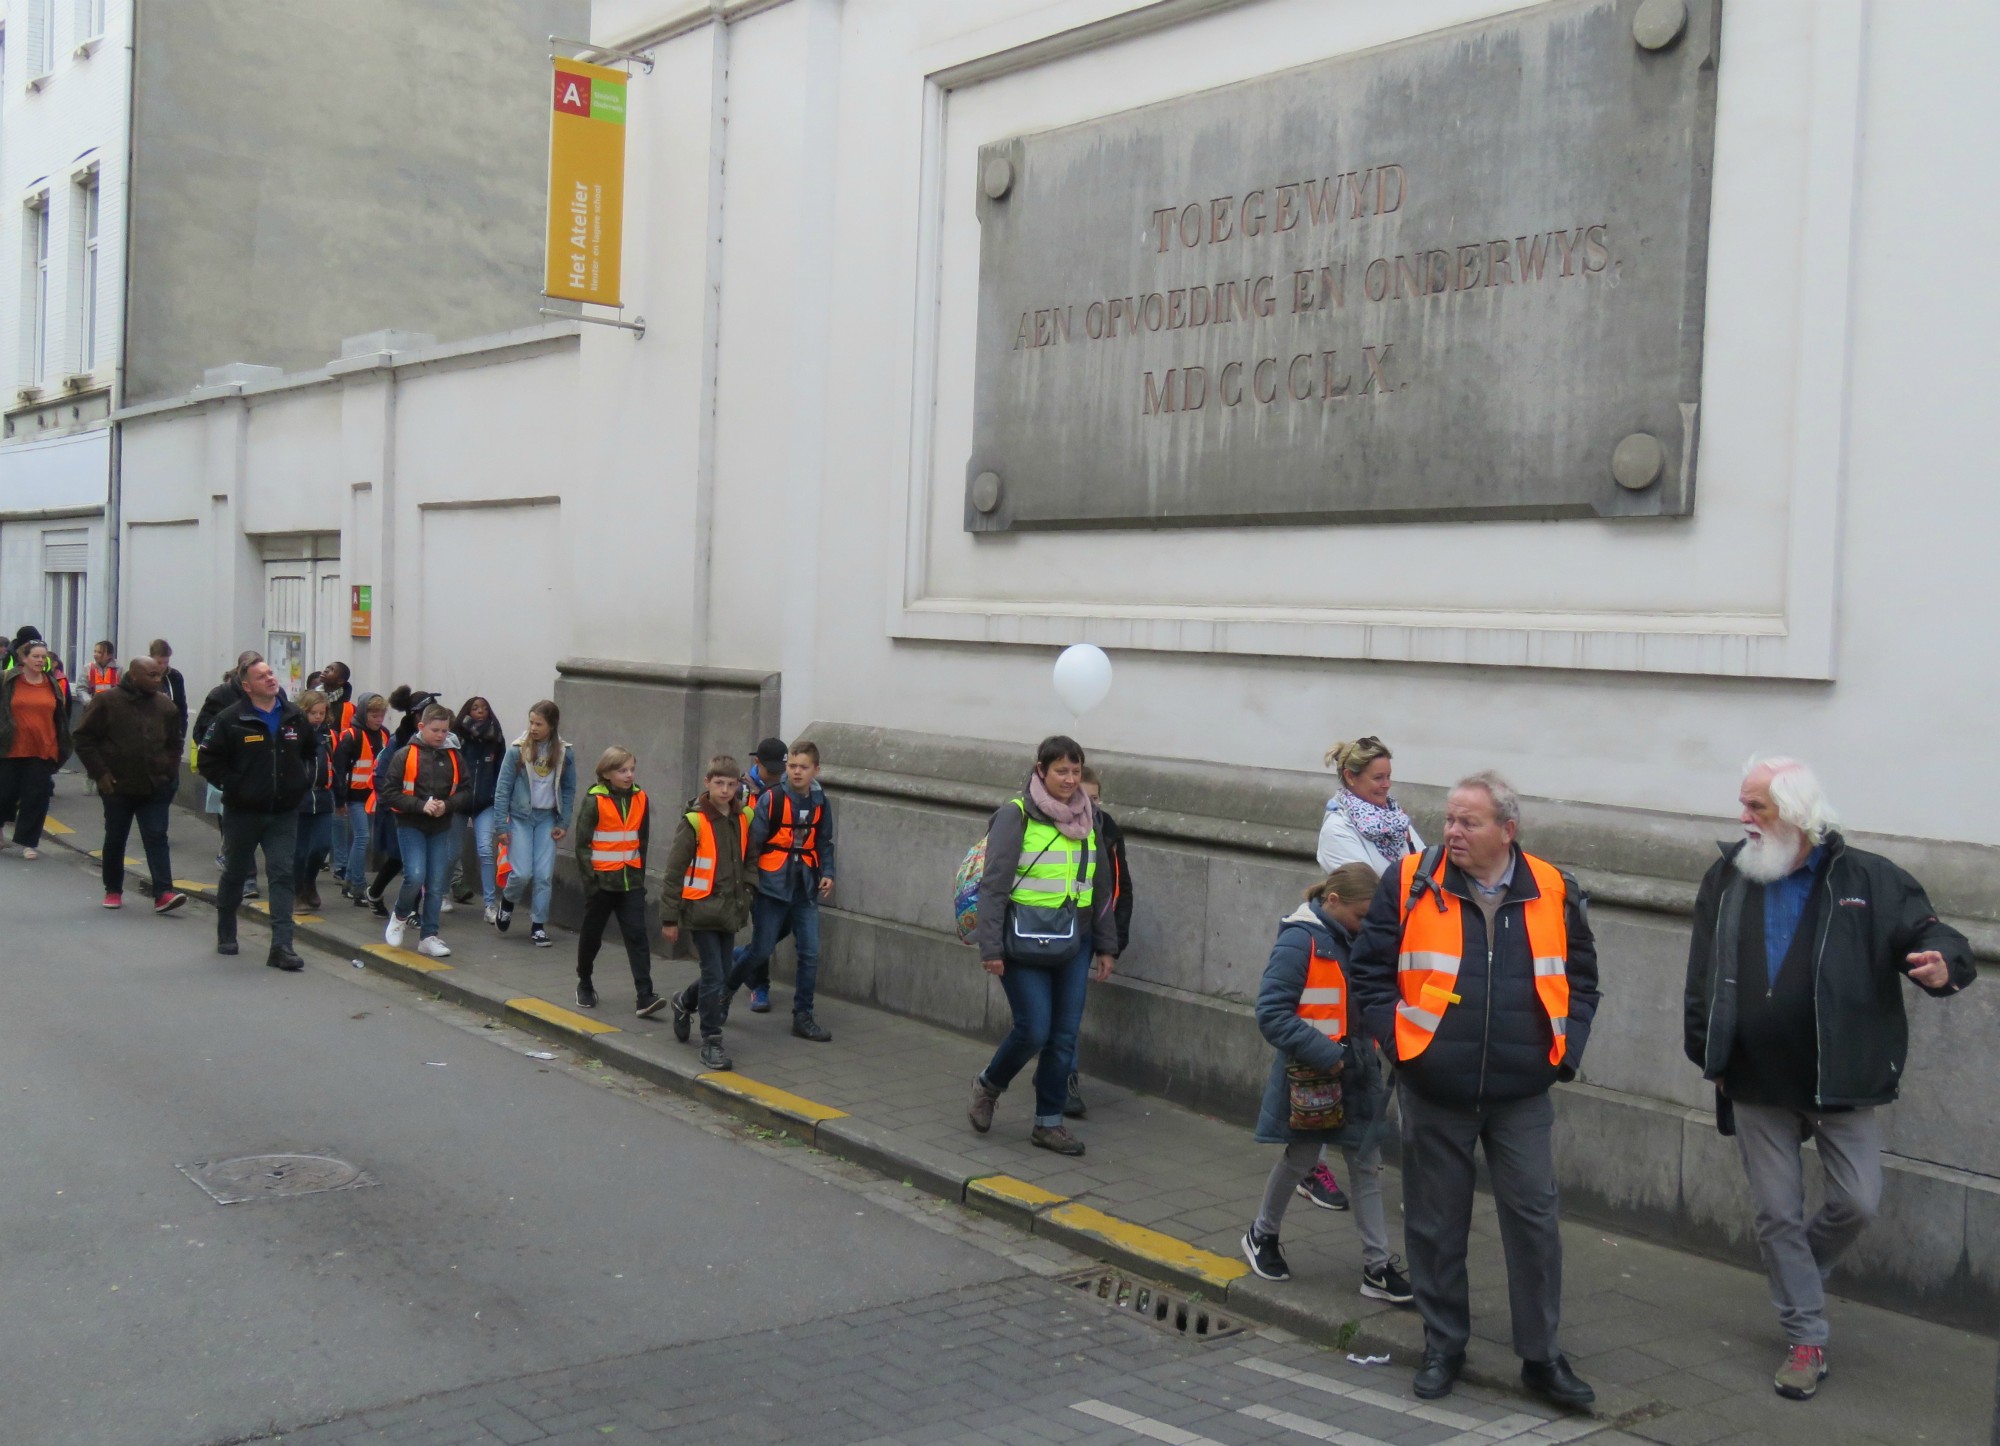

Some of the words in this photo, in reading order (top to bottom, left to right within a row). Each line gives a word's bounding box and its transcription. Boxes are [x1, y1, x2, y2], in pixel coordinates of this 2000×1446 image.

[563, 82, 581, 107] A
[570, 181, 588, 249] Atelier
[593, 184, 602, 213] school
[1151, 163, 1408, 254] TOEGEWYD
[593, 245, 600, 256] en
[569, 253, 586, 289] Het
[1013, 304, 1073, 350] AEN
[1085, 275, 1277, 340] OPVOEDING
[1291, 264, 1346, 314] EN
[1364, 223, 1623, 303] ONDERWYS.
